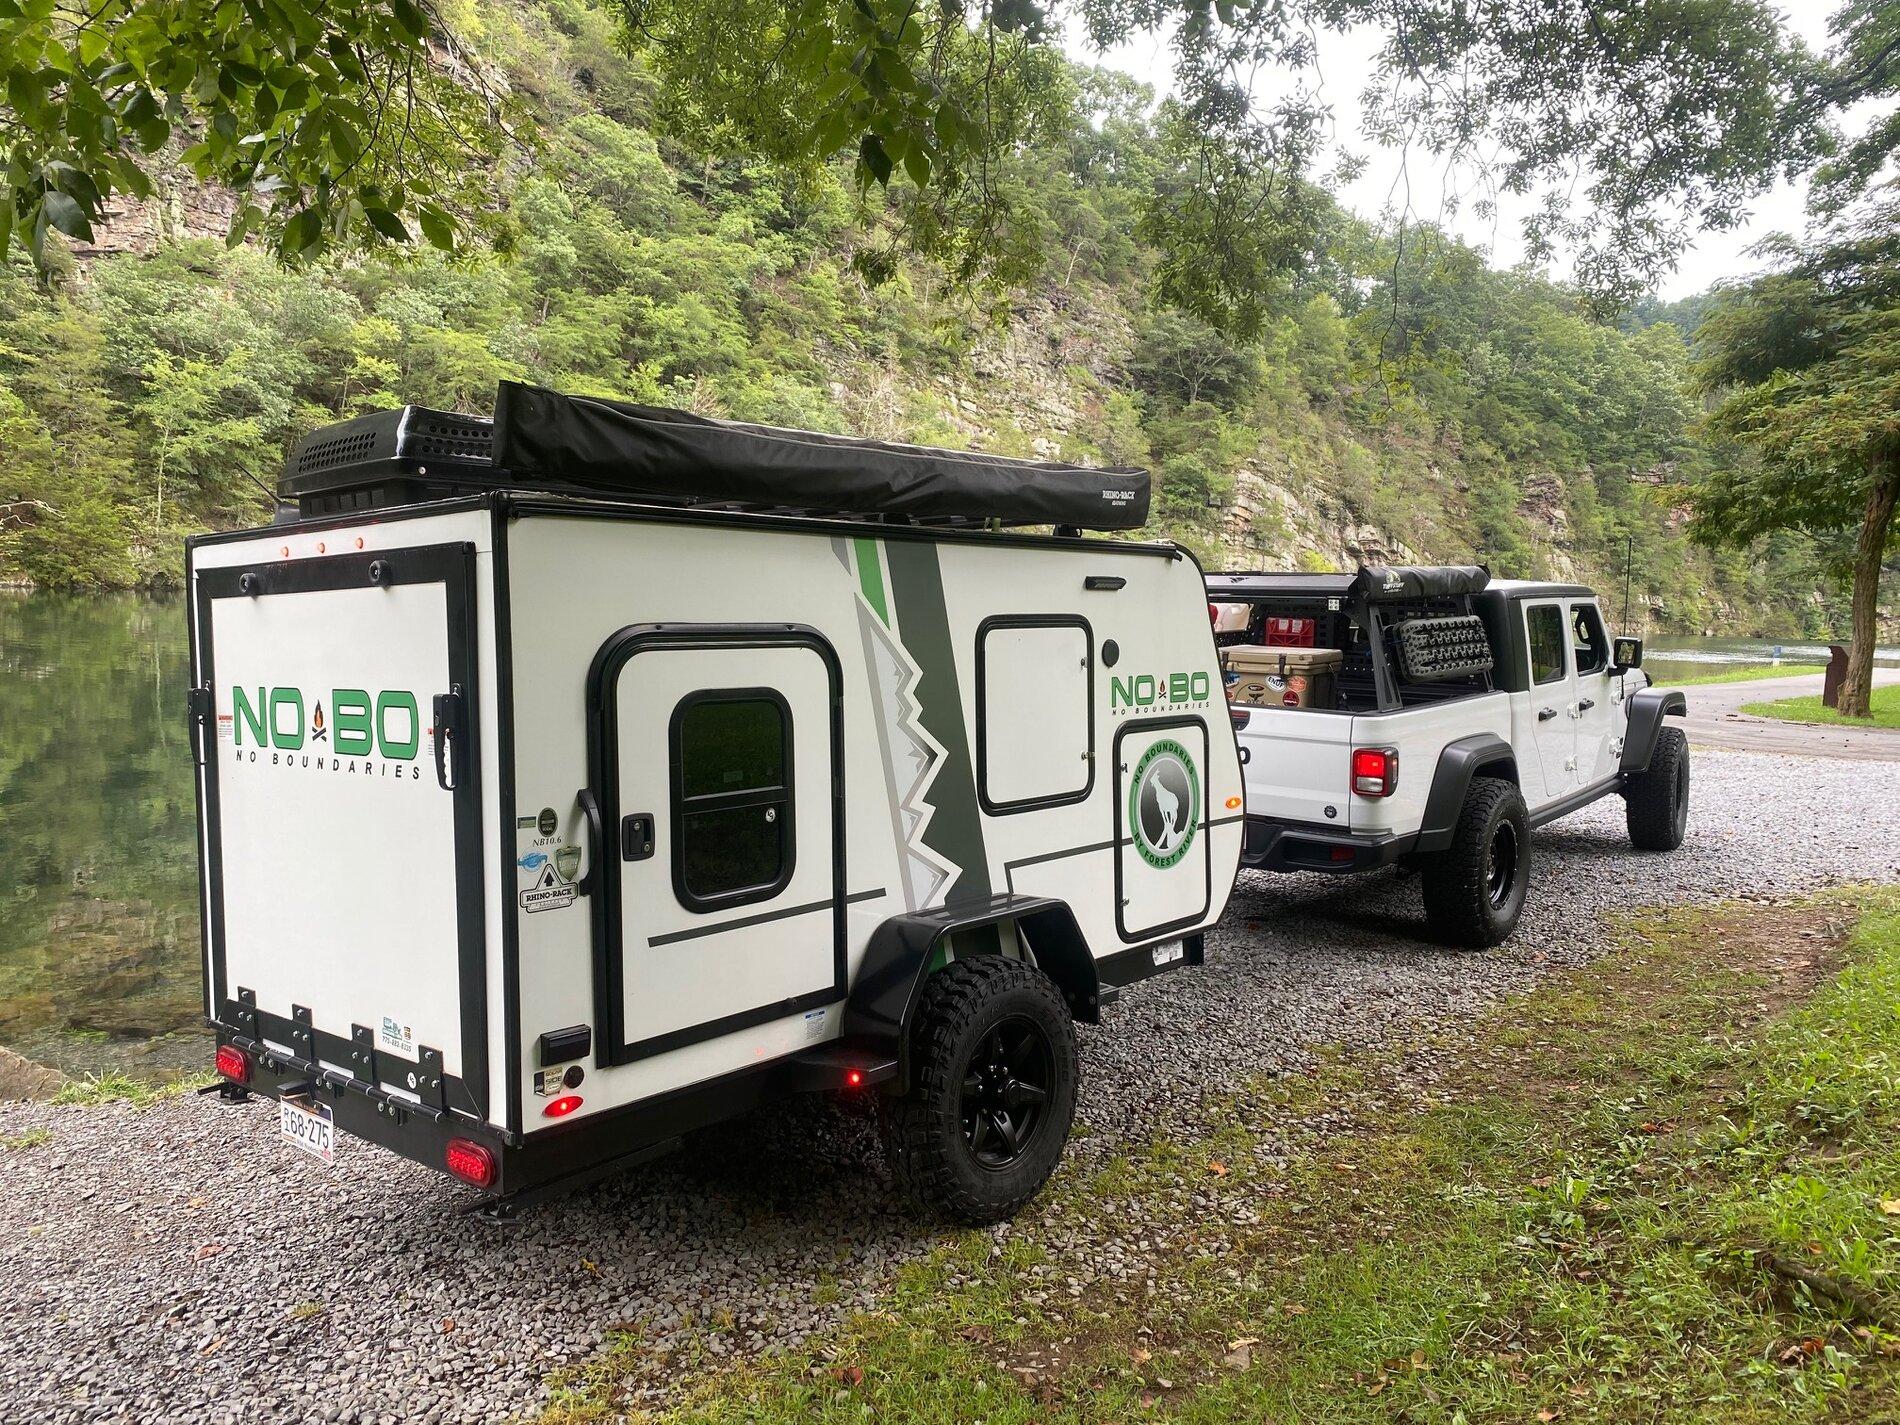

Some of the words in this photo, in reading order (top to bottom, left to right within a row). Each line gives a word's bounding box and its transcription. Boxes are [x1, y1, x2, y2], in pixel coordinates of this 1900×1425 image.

[1111, 707, 1126, 715] NO
[1135, 701, 1210, 714] BOUNDARIES
[236, 749, 257, 763] NO
[272, 755, 420, 780] BOUNDARIES
[1134, 765, 1144, 784] NO
[1145, 742, 1194, 775] BOUNDARIES
[532, 835, 562, 848] NB10.6
[1134, 832, 1144, 849] BY
[1144, 850, 1176, 867] FOREST
[1179, 819, 1197, 856] RIVER
[526, 888, 573, 902] RHINO-RACK
